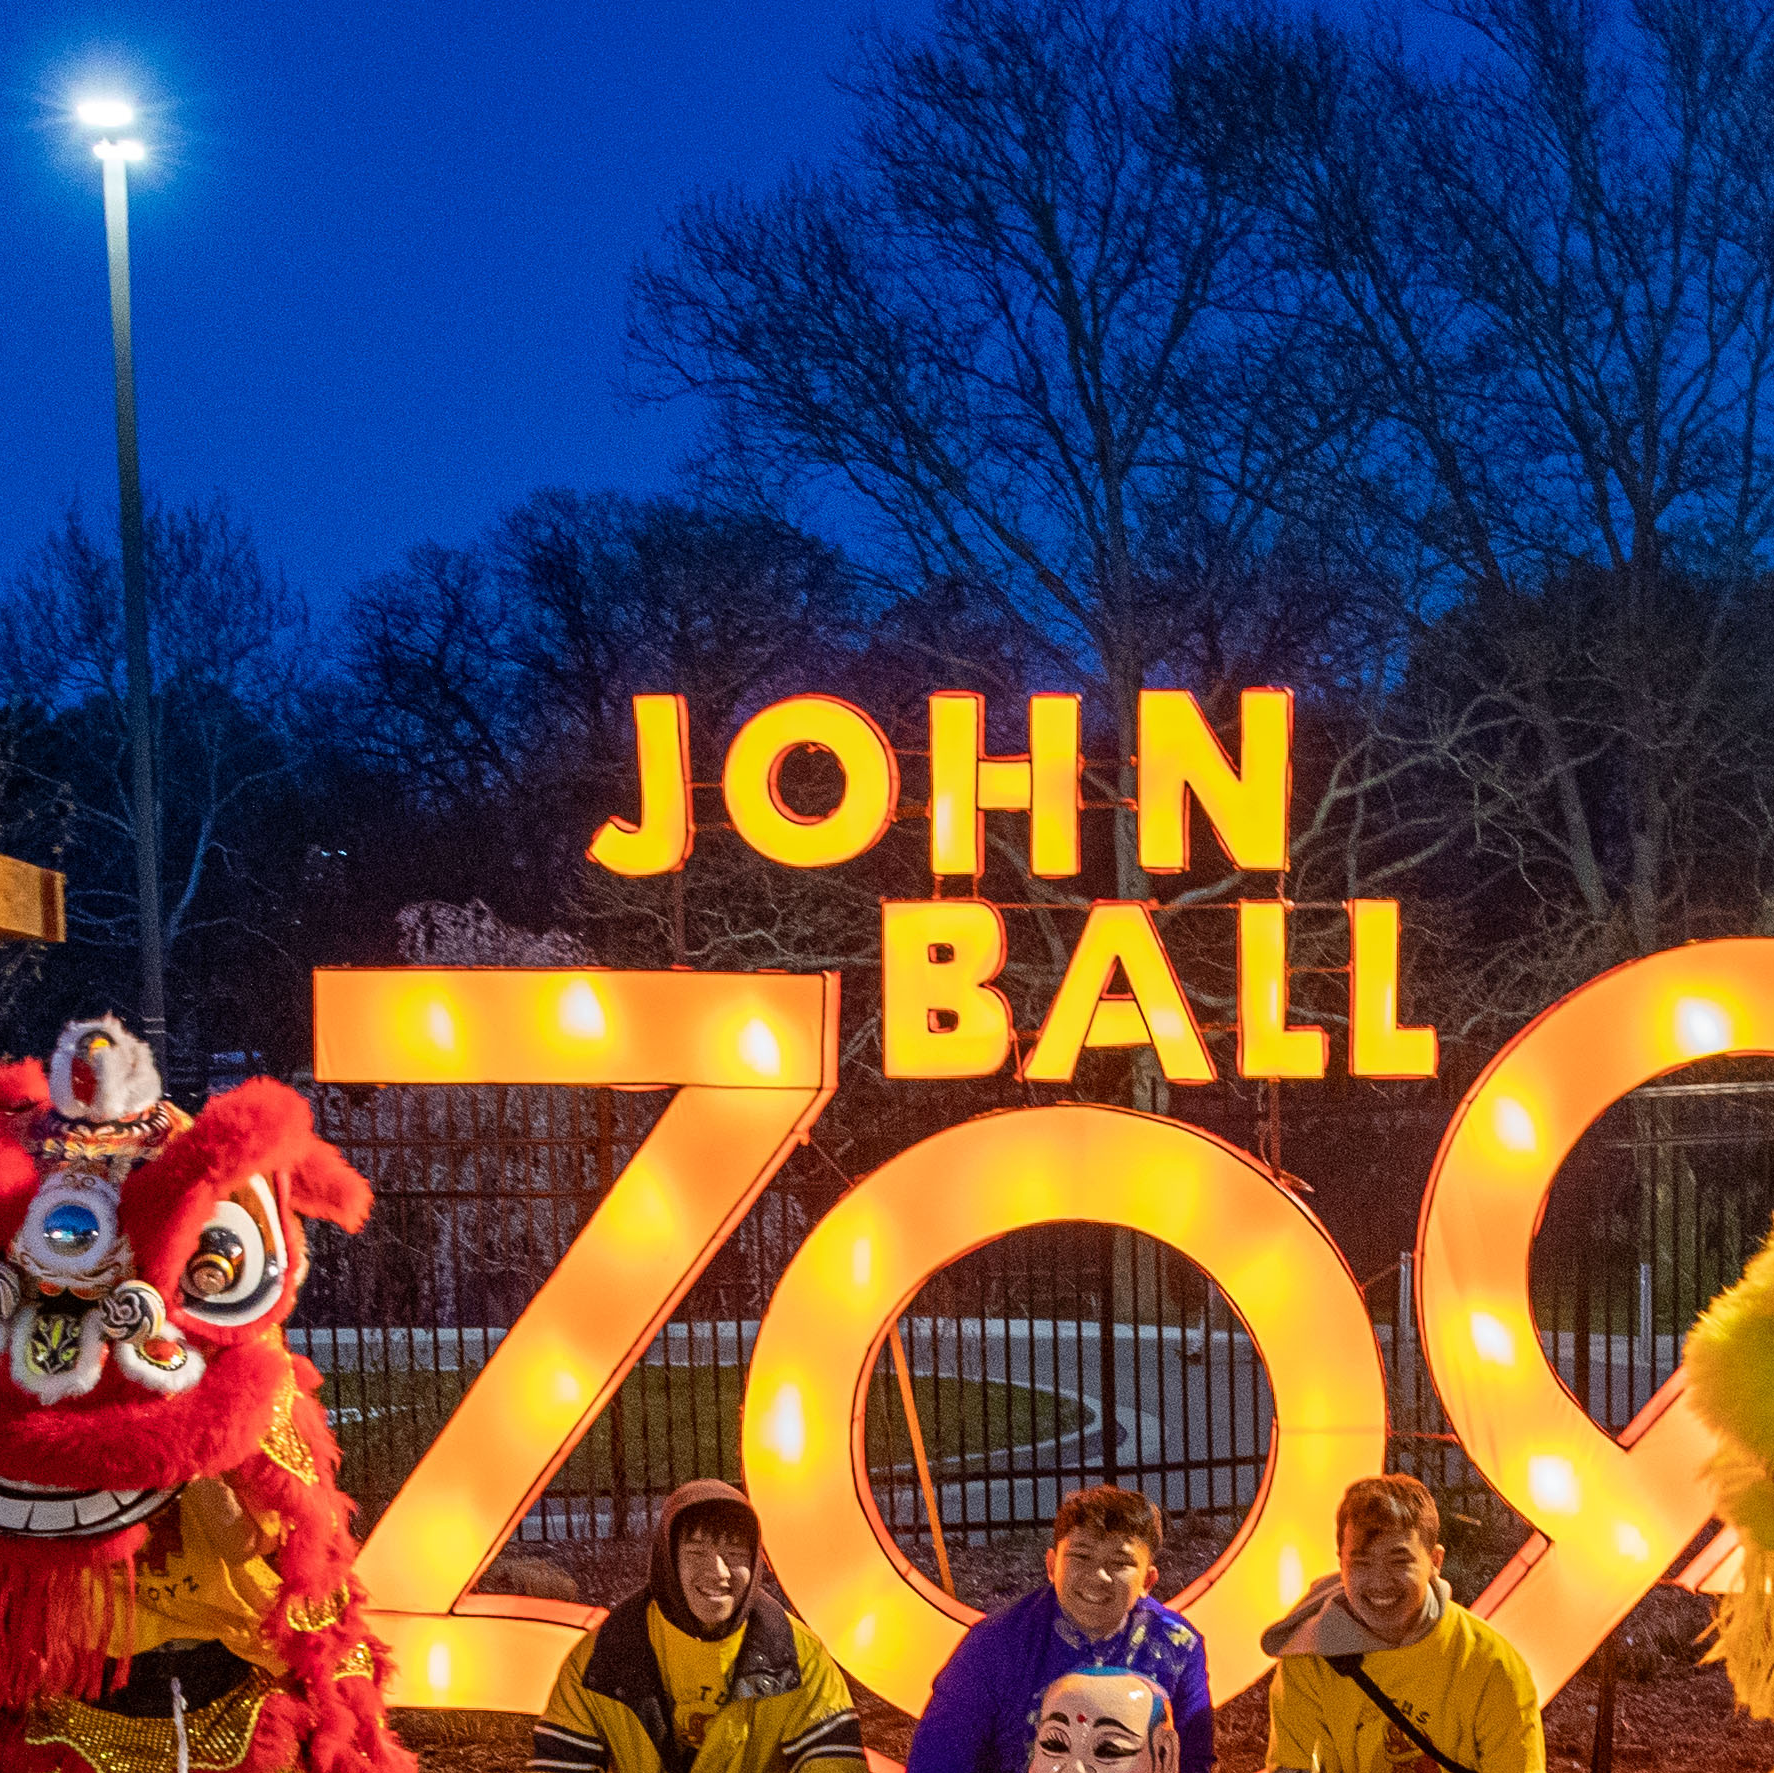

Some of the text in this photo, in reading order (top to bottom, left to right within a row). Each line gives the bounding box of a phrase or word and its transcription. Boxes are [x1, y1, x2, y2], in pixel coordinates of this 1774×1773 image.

[585, 686, 1294, 878] JOHN
[882, 898, 1439, 1085] BALL
[135, 1575, 200, 1601] OYZ
